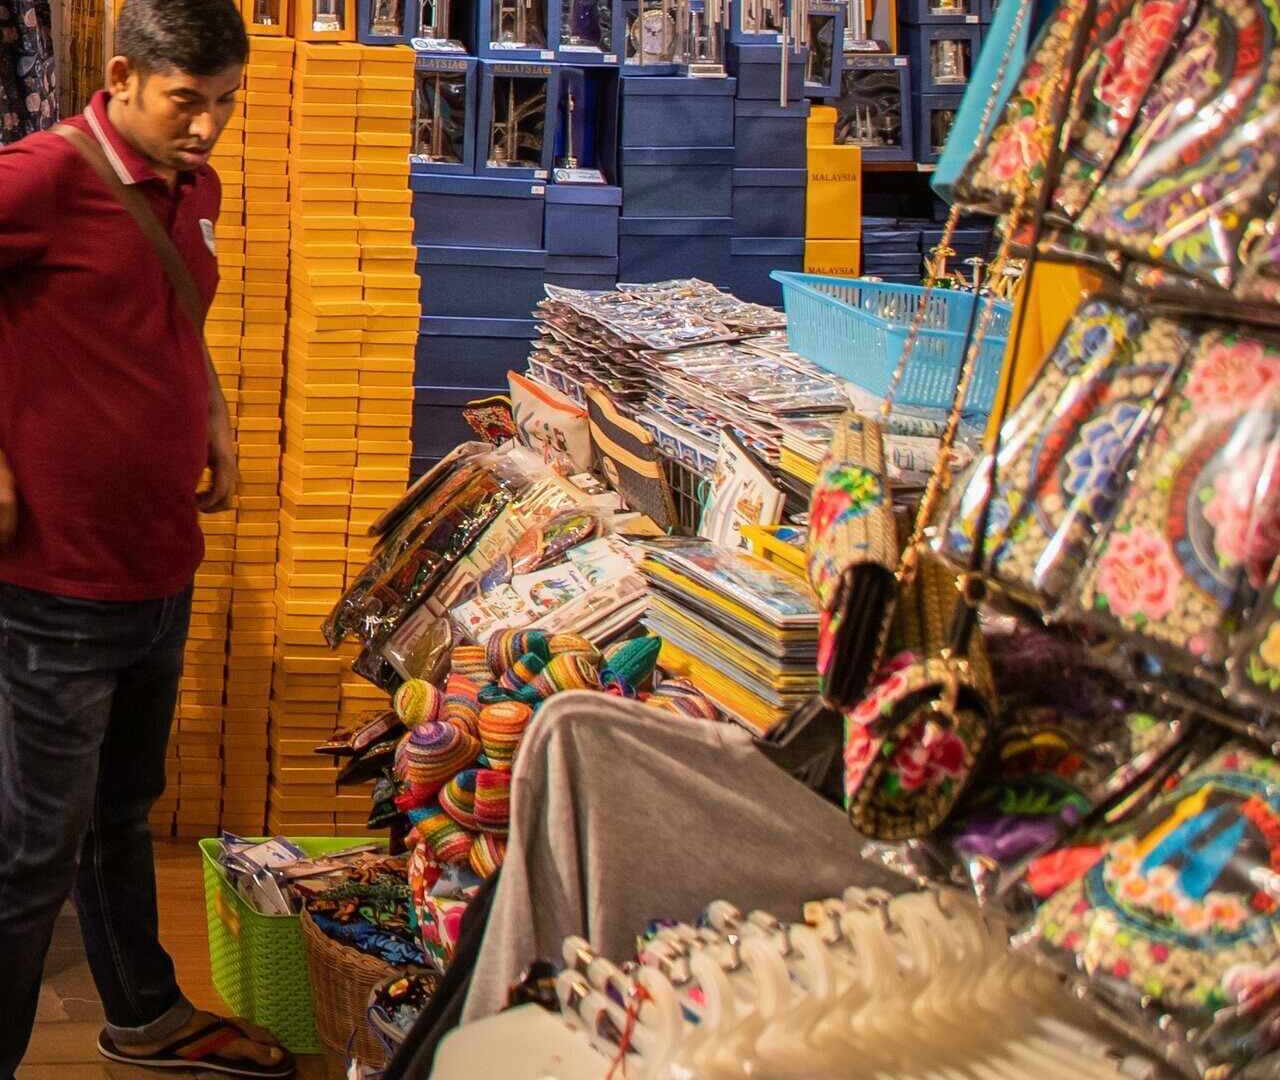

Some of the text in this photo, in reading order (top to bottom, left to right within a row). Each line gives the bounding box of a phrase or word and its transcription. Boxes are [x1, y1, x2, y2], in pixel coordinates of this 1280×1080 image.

[416, 58, 459, 70] ALAYSIA
[494, 64, 542, 74] MALAYSIA
[812, 173, 857, 181] MALAYSIA
[808, 266, 855, 275] MALAYSIA
